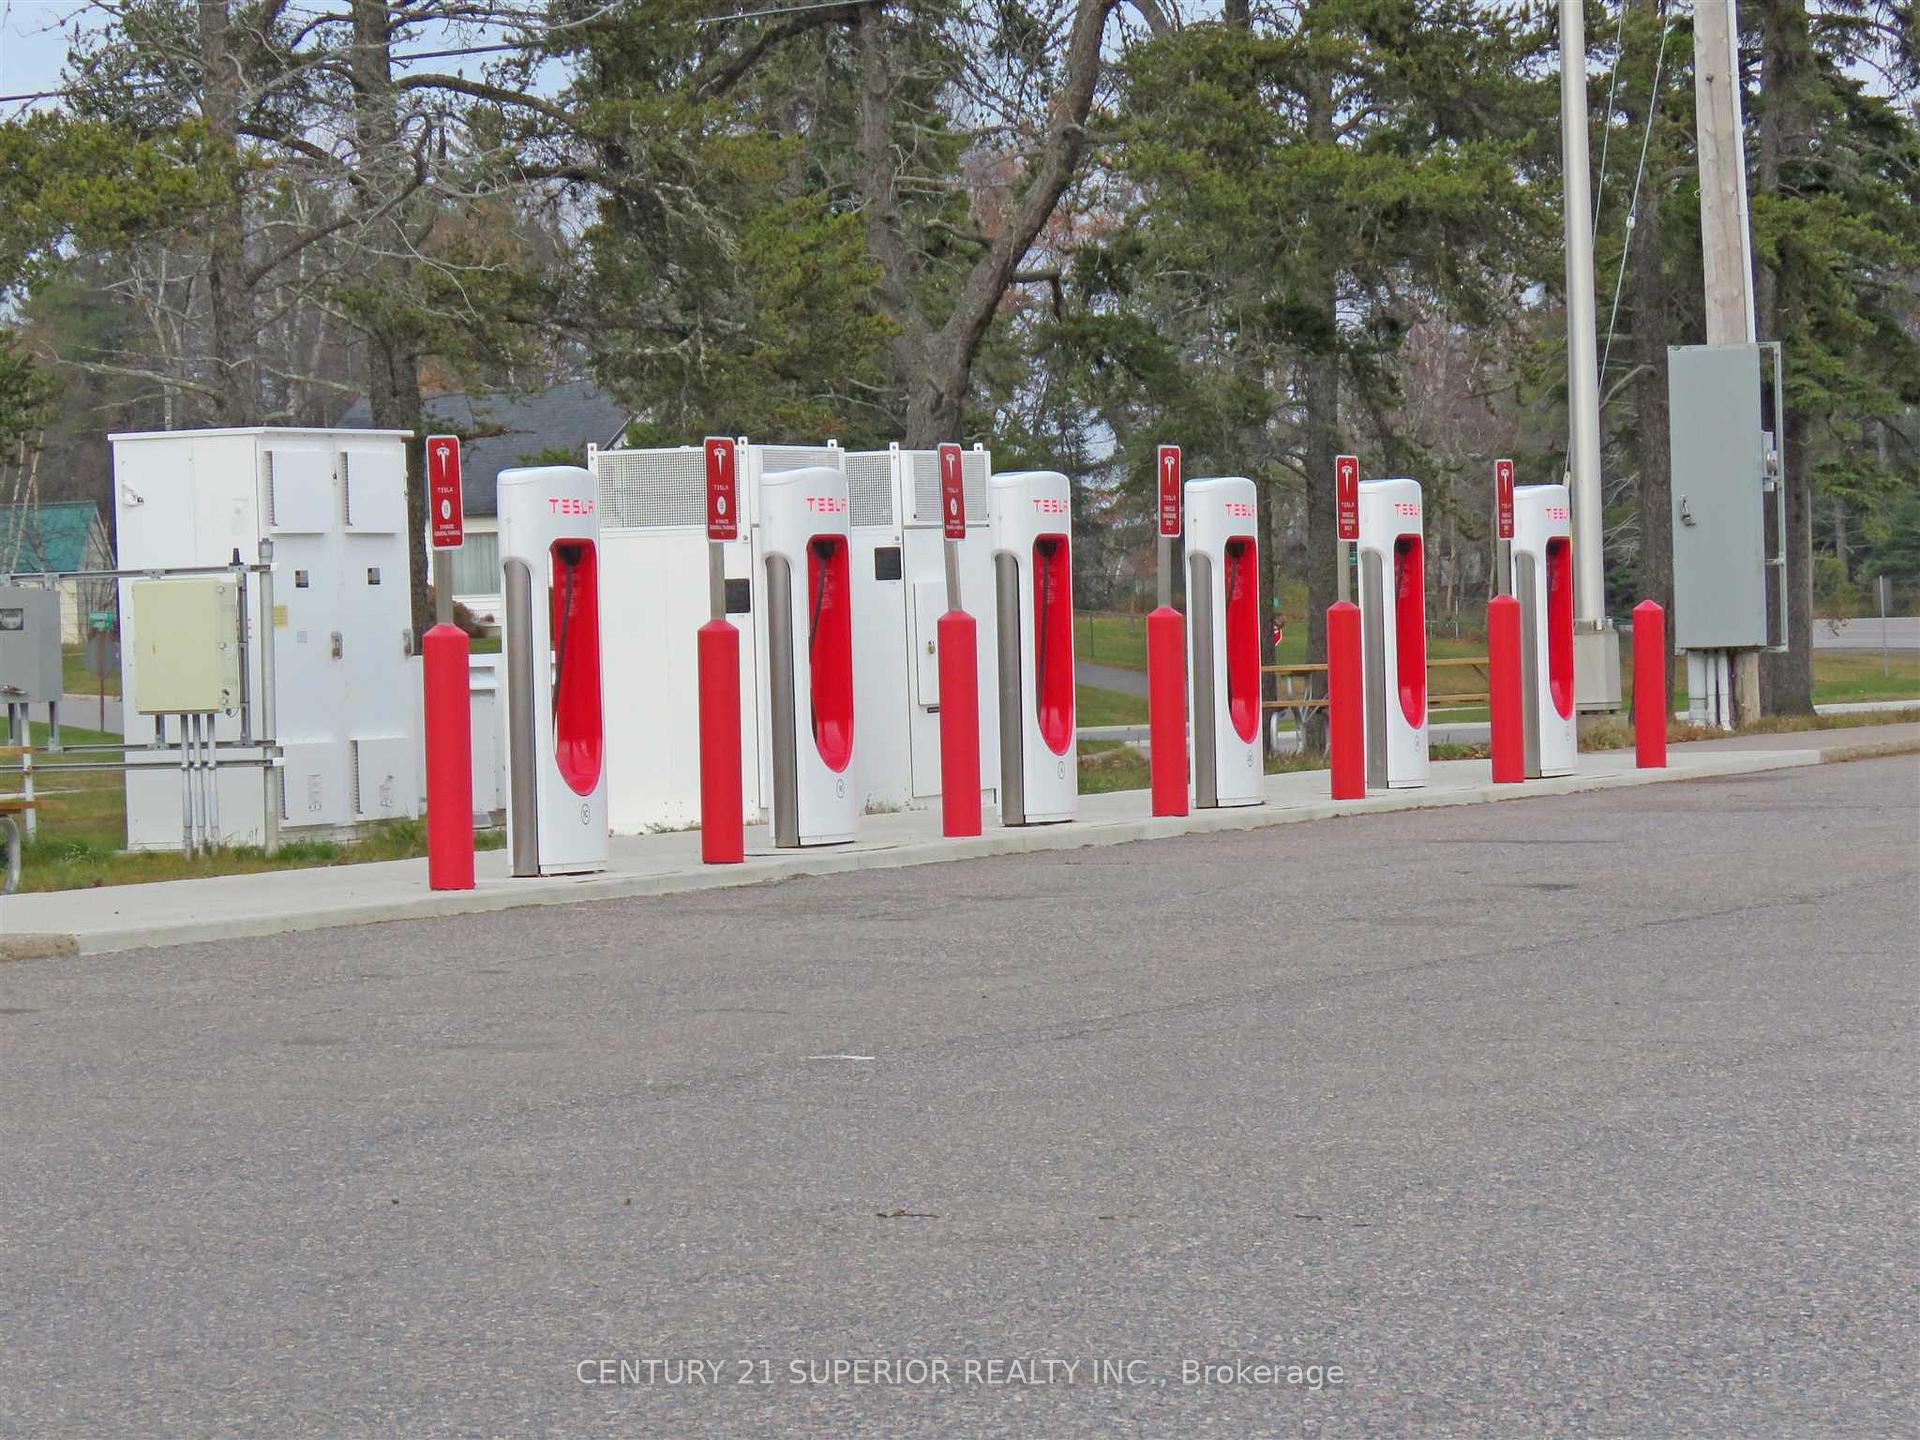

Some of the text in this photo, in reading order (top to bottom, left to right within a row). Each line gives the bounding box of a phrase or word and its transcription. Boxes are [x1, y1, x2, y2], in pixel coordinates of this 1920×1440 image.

[437, 486, 454, 494] TESLA
[548, 498, 594, 515] TESLA
[806, 497, 847, 512] TESLA
[1033, 498, 1068, 514] TESLA
[1225, 504, 1255, 517] TESLA
